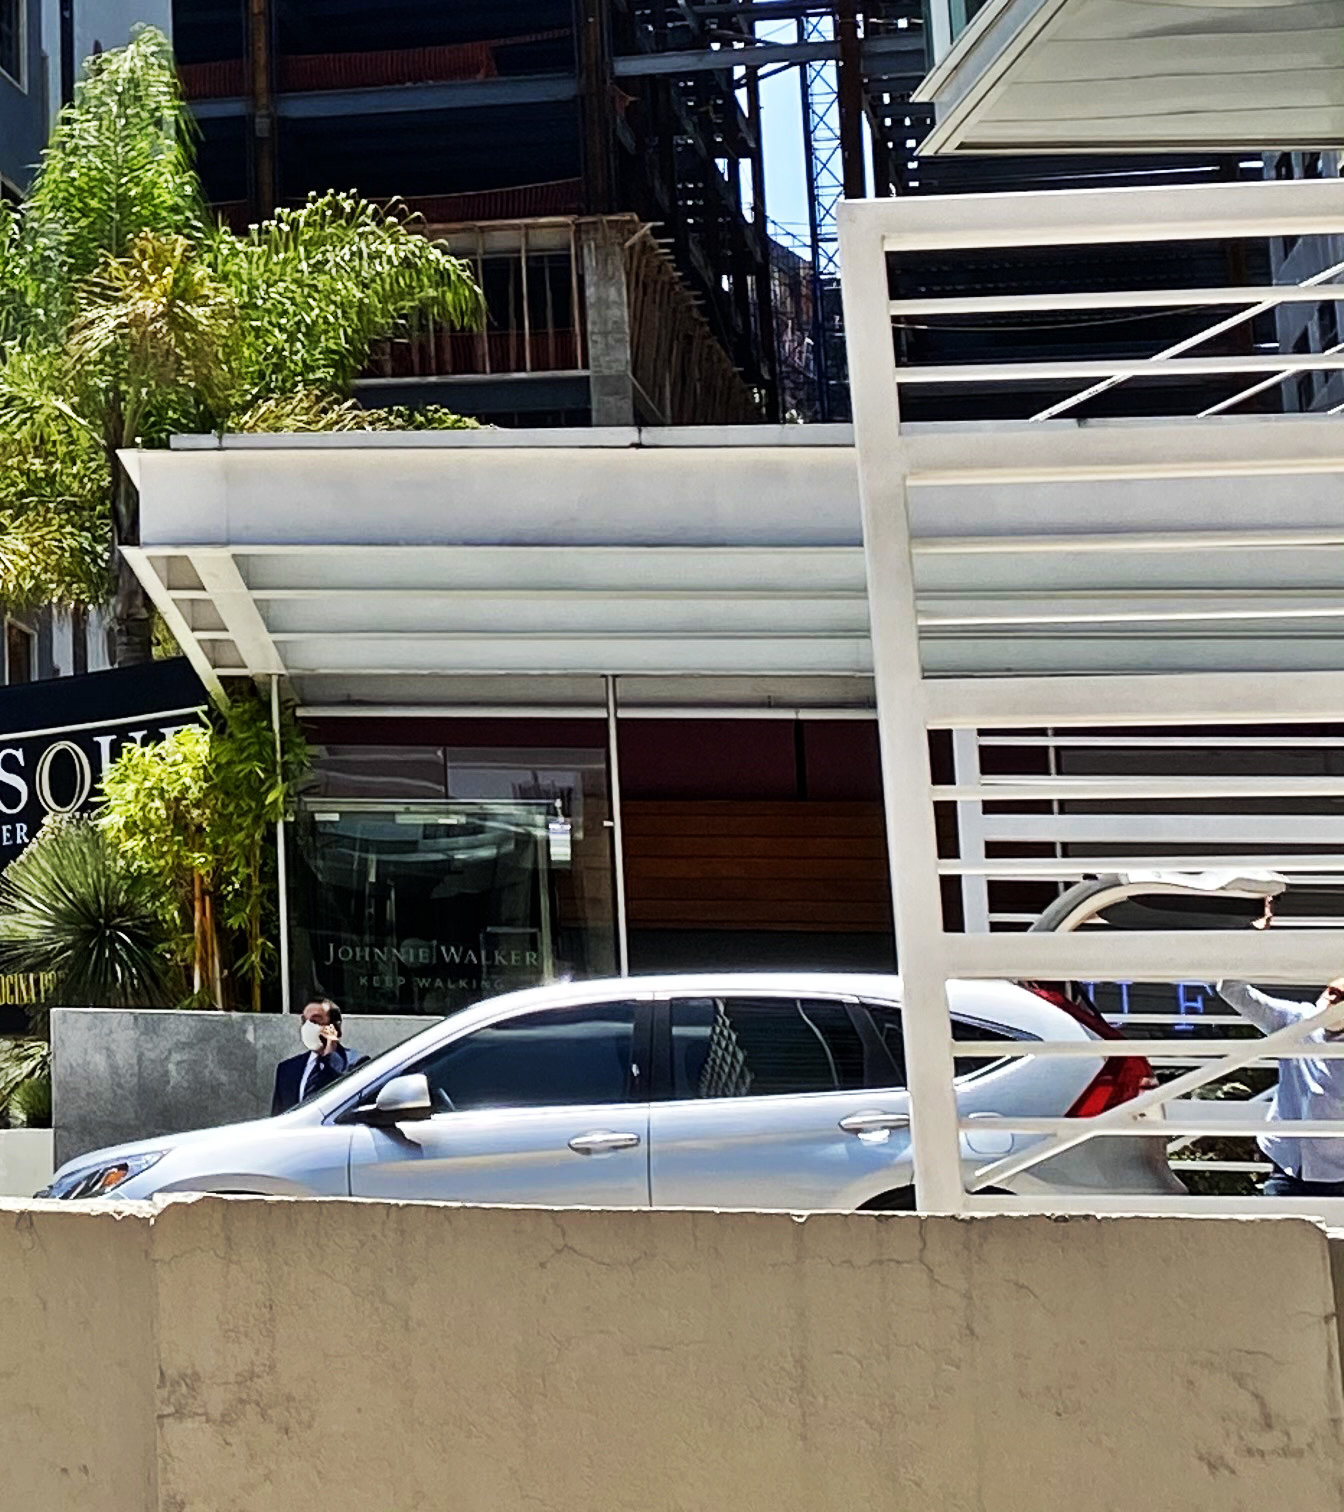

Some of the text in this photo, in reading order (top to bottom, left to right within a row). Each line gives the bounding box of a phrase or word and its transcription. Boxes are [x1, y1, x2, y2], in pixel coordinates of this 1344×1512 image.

[324, 942, 540, 966] JOHNNIE WALKER
[359, 975, 506, 989] KEEP WALKING
